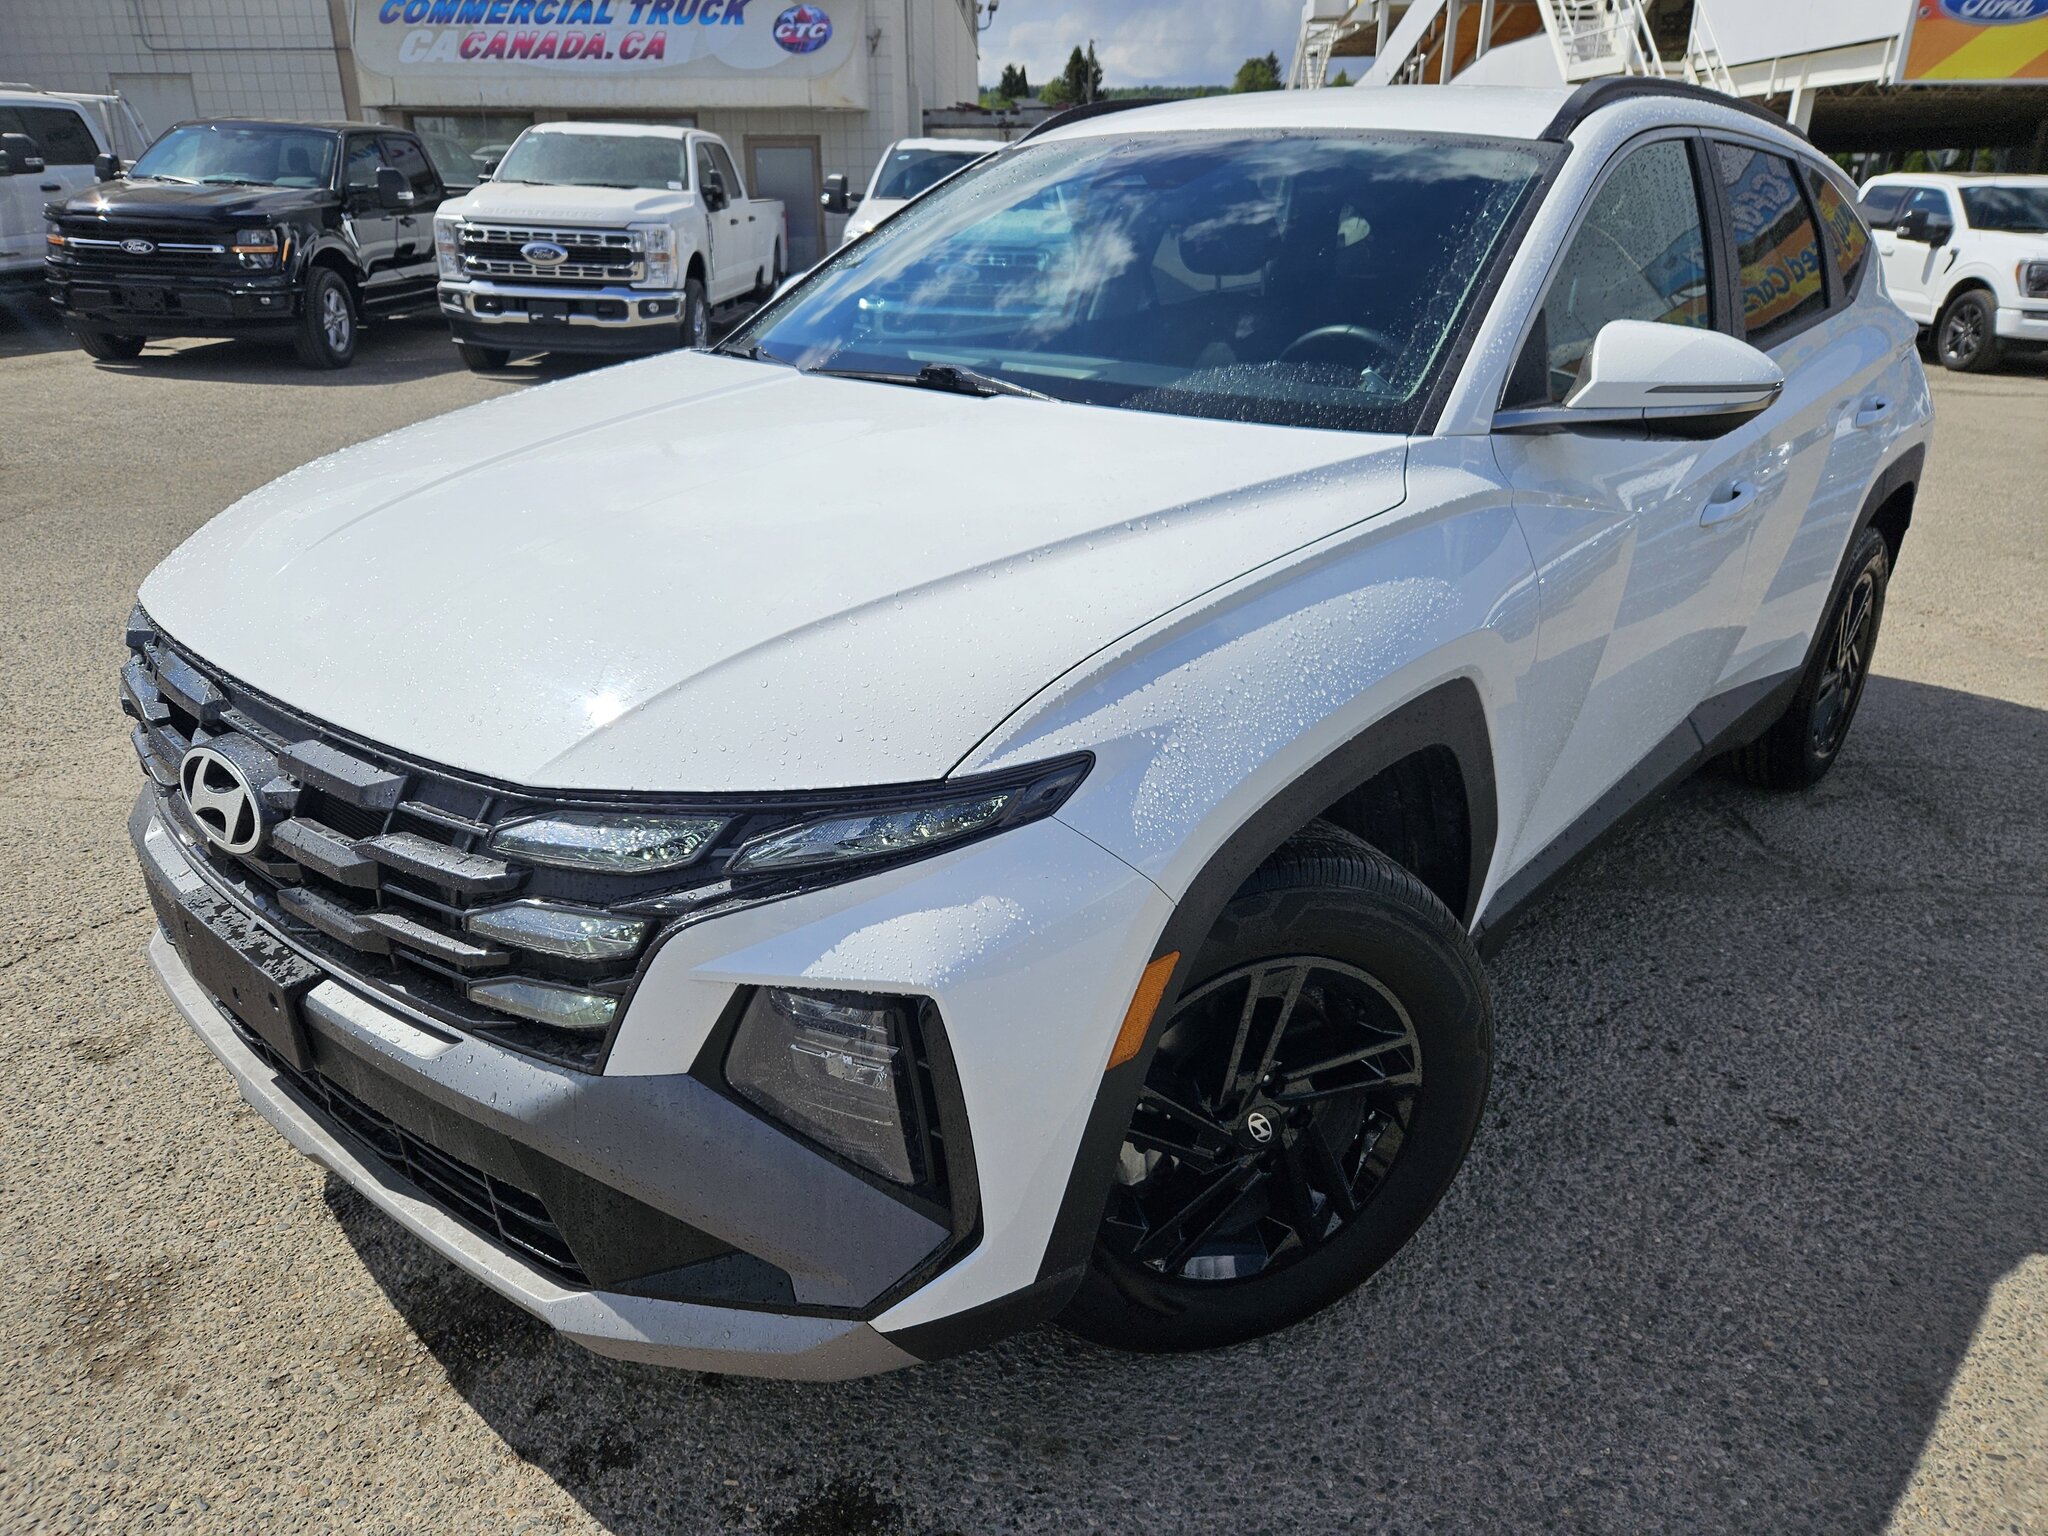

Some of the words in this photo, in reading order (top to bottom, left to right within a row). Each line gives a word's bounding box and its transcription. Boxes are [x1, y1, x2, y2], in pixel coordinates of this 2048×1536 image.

[378, 0, 615, 25] COMMERCIAL
[628, 0, 749, 26] TRUCK
[775, 22, 828, 39] CTC
[459, 30, 667, 61] CANADA.CA
[126, 240, 147, 251] Ford
[531, 248, 555, 261] Ford
